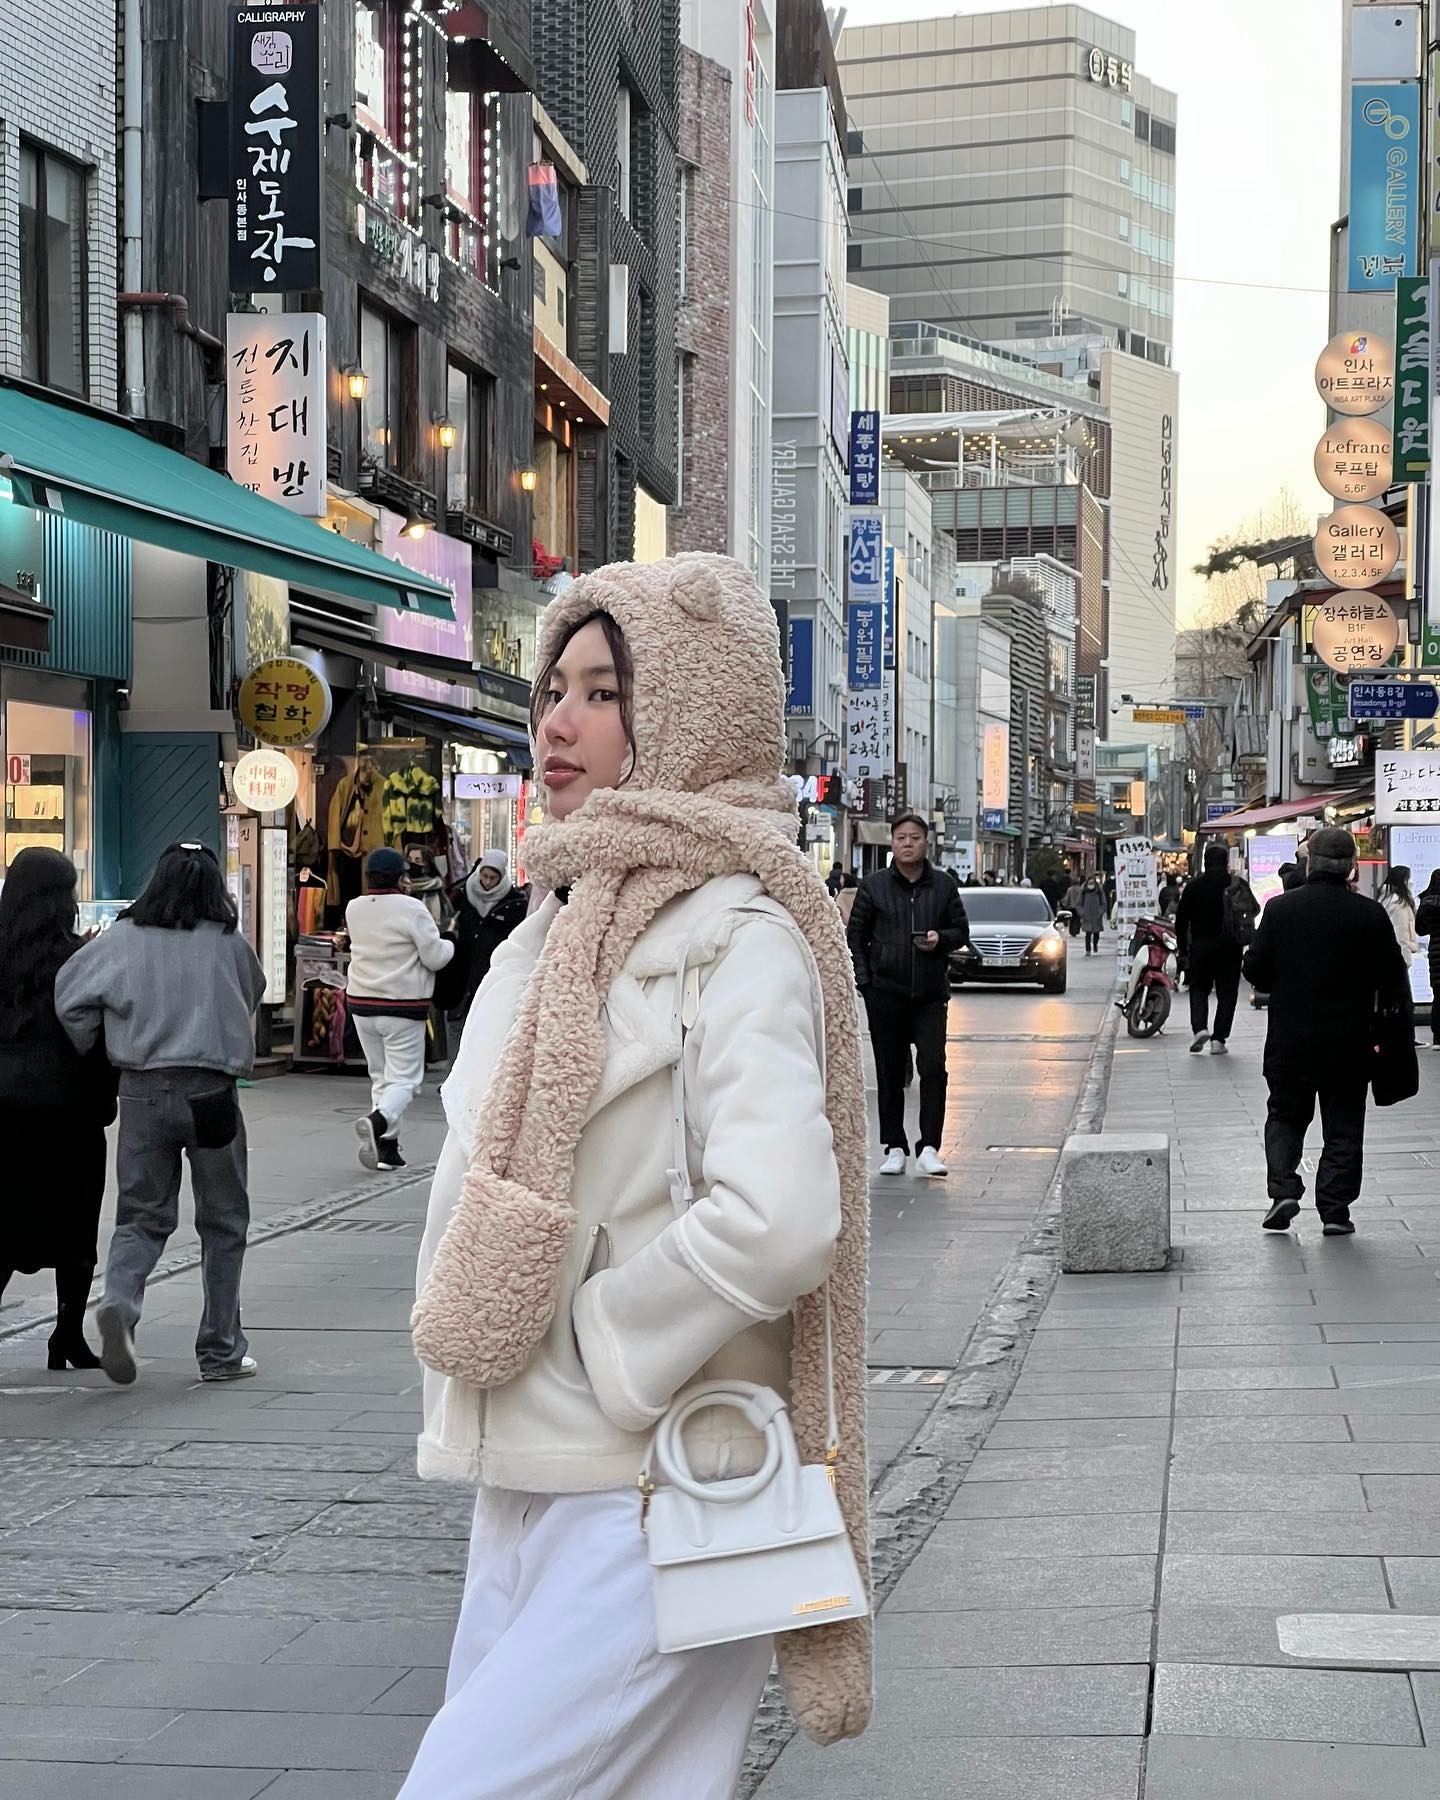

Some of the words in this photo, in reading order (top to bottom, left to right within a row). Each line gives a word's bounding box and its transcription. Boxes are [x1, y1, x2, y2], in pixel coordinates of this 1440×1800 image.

[237, 11, 306, 23] CALLIGRAPHY
[244, 82, 316, 282] 수제도장
[1384, 147, 1408, 245] GALLERY
[236, 179, 248, 241] 인사동본점
[1344, 358, 1375, 374] 인사
[232, 343, 260, 465] 전통찻집
[265, 329, 310, 497] 지대방
[854, 414, 876, 489] 세종화랑
[1325, 439, 1391, 454] Lefranc
[771, 439, 797, 508] GALLERY
[1333, 461, 1379, 477] 루프탑
[1328, 524, 1385, 538] Gallery
[850, 535, 881, 582] 서예
[1332, 543, 1385, 562] 갤러리
[771, 560, 796, 589] THE
[1324, 604, 1389, 623] 장수하늘소
[1348, 624, 1366, 632] B1F
[855, 609, 875, 680] 봉원필방
[1332, 644, 1384, 663] 공연장
[254, 682, 310, 701] 작명
[1353, 686, 1405, 698] 인사동8길
[850, 696, 879, 712] 인사동
[1353, 699, 1387, 708] Insadong
[254, 702, 312, 726] 철학
[249, 764, 277, 780] 中國
[248, 782, 277, 797] 料理
